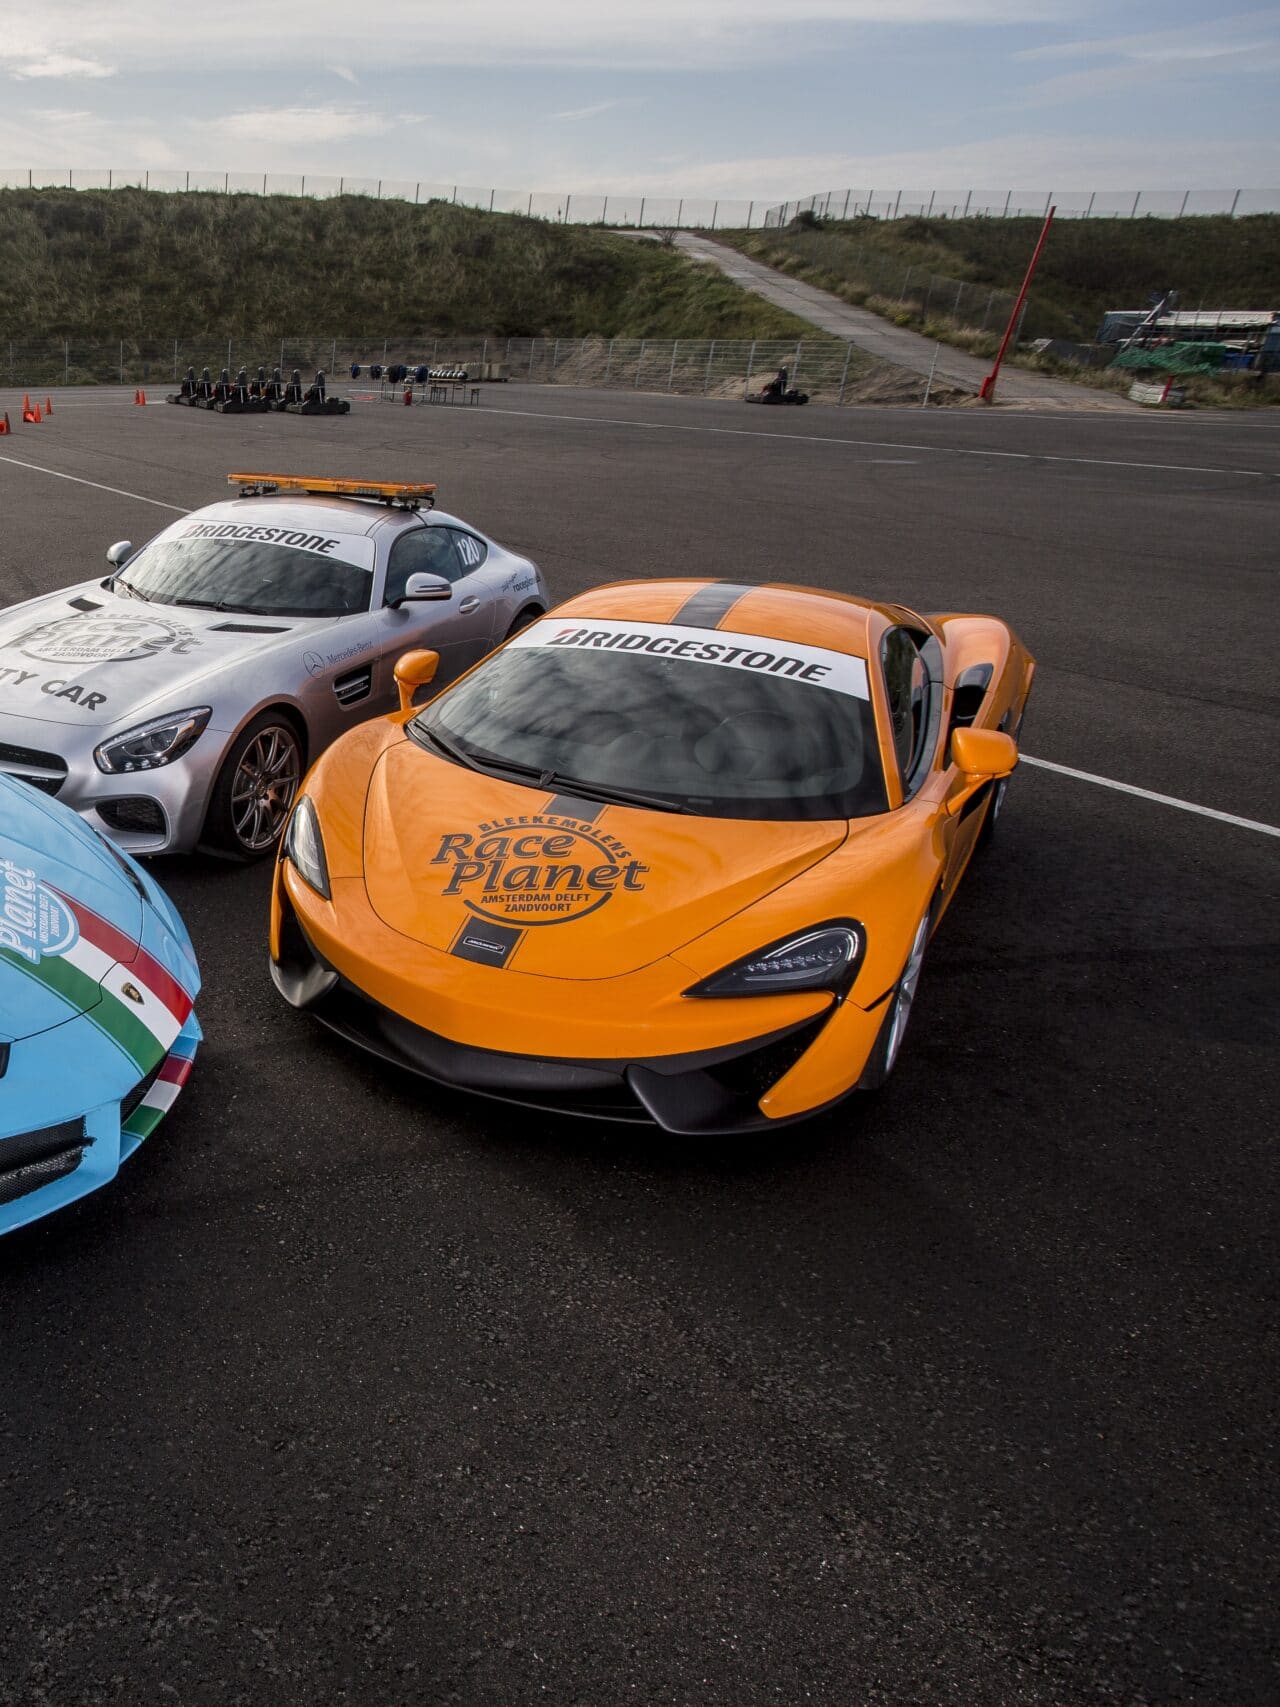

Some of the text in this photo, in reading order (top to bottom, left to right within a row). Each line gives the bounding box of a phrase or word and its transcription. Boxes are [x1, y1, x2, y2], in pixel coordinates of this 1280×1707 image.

[179, 524, 341, 554] BRIDGESTONE
[457, 536, 480, 566] 120
[546, 628, 832, 682] BRIDGESTONE
[40, 679, 108, 712] CAR
[429, 832, 577, 865] Race
[478, 815, 632, 859] BLEEKEMOLENS
[441, 859, 650, 896] Planet
[481, 893, 591, 904] AMSTERDAM DELFT
[504, 903, 572, 913] ZANDVOORT
